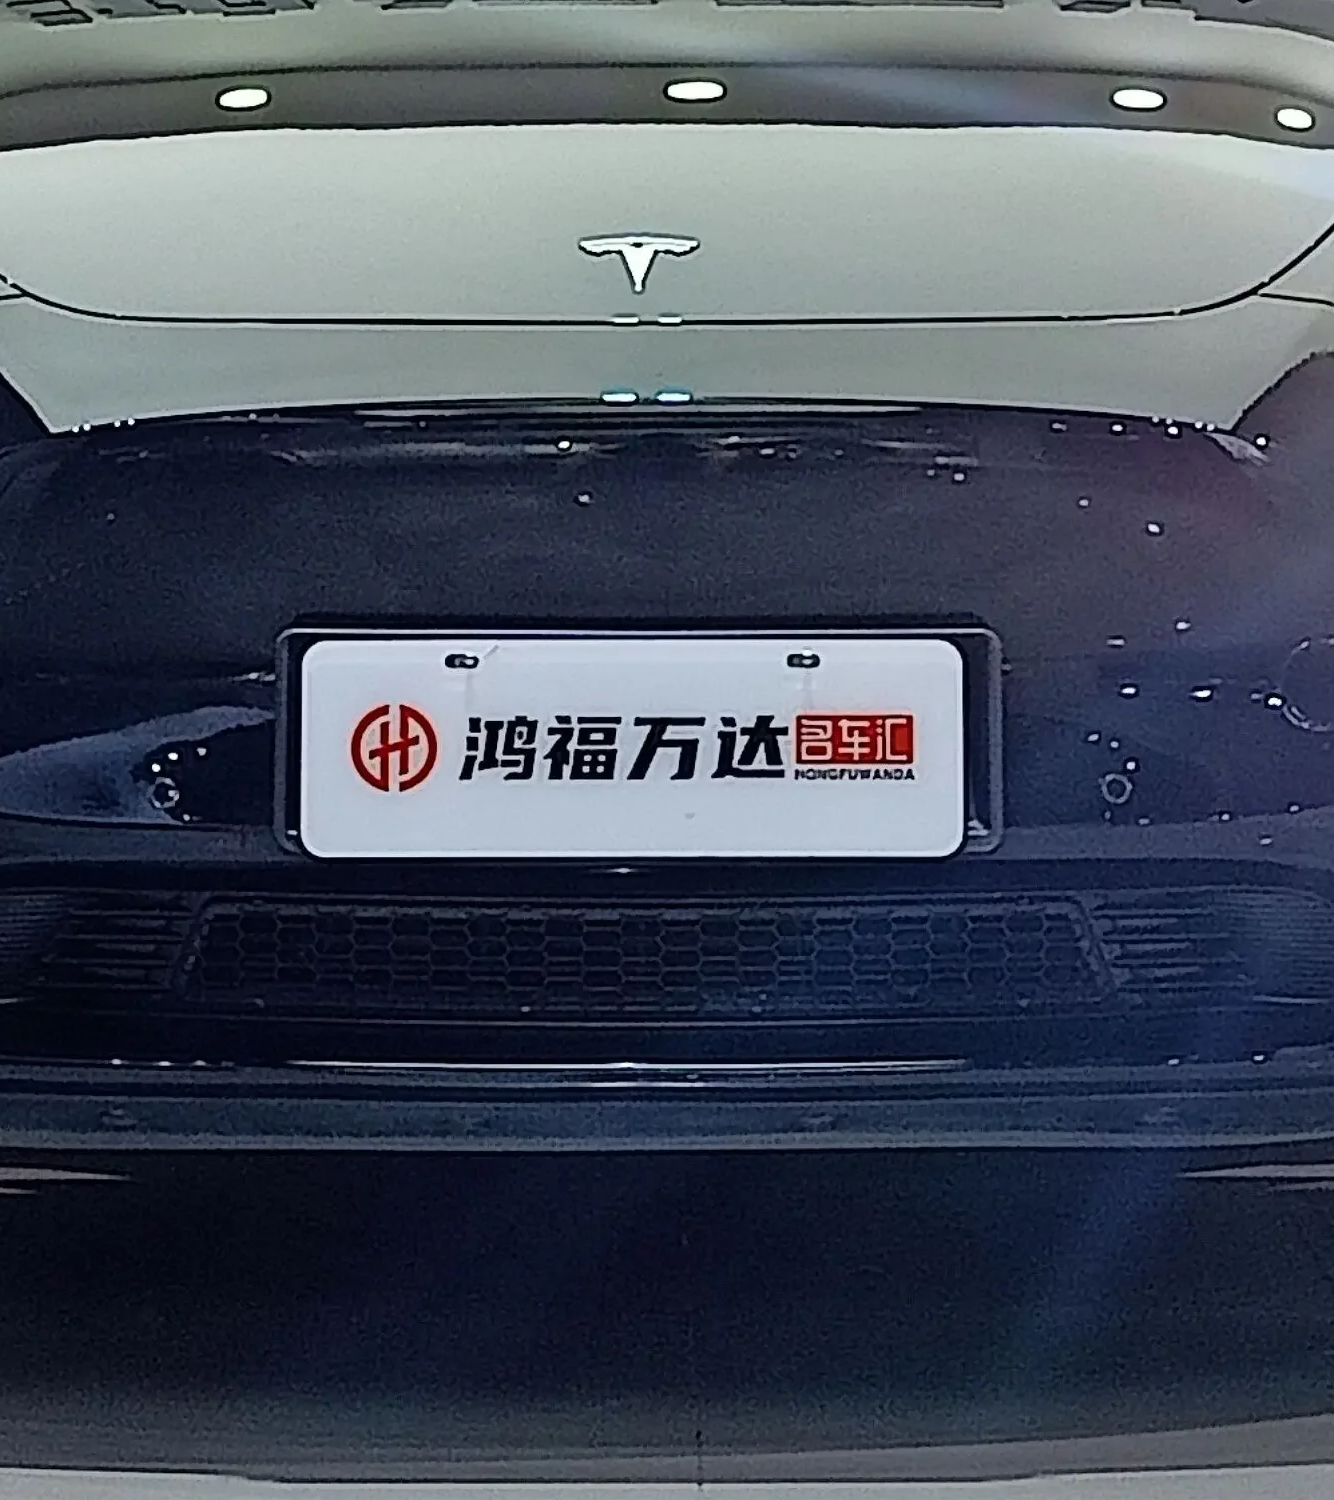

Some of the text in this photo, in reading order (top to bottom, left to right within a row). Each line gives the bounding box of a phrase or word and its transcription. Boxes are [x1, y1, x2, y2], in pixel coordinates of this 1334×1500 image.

[459, 715, 789, 781] 鸿福万达
[800, 718, 908, 761] 名车汇
